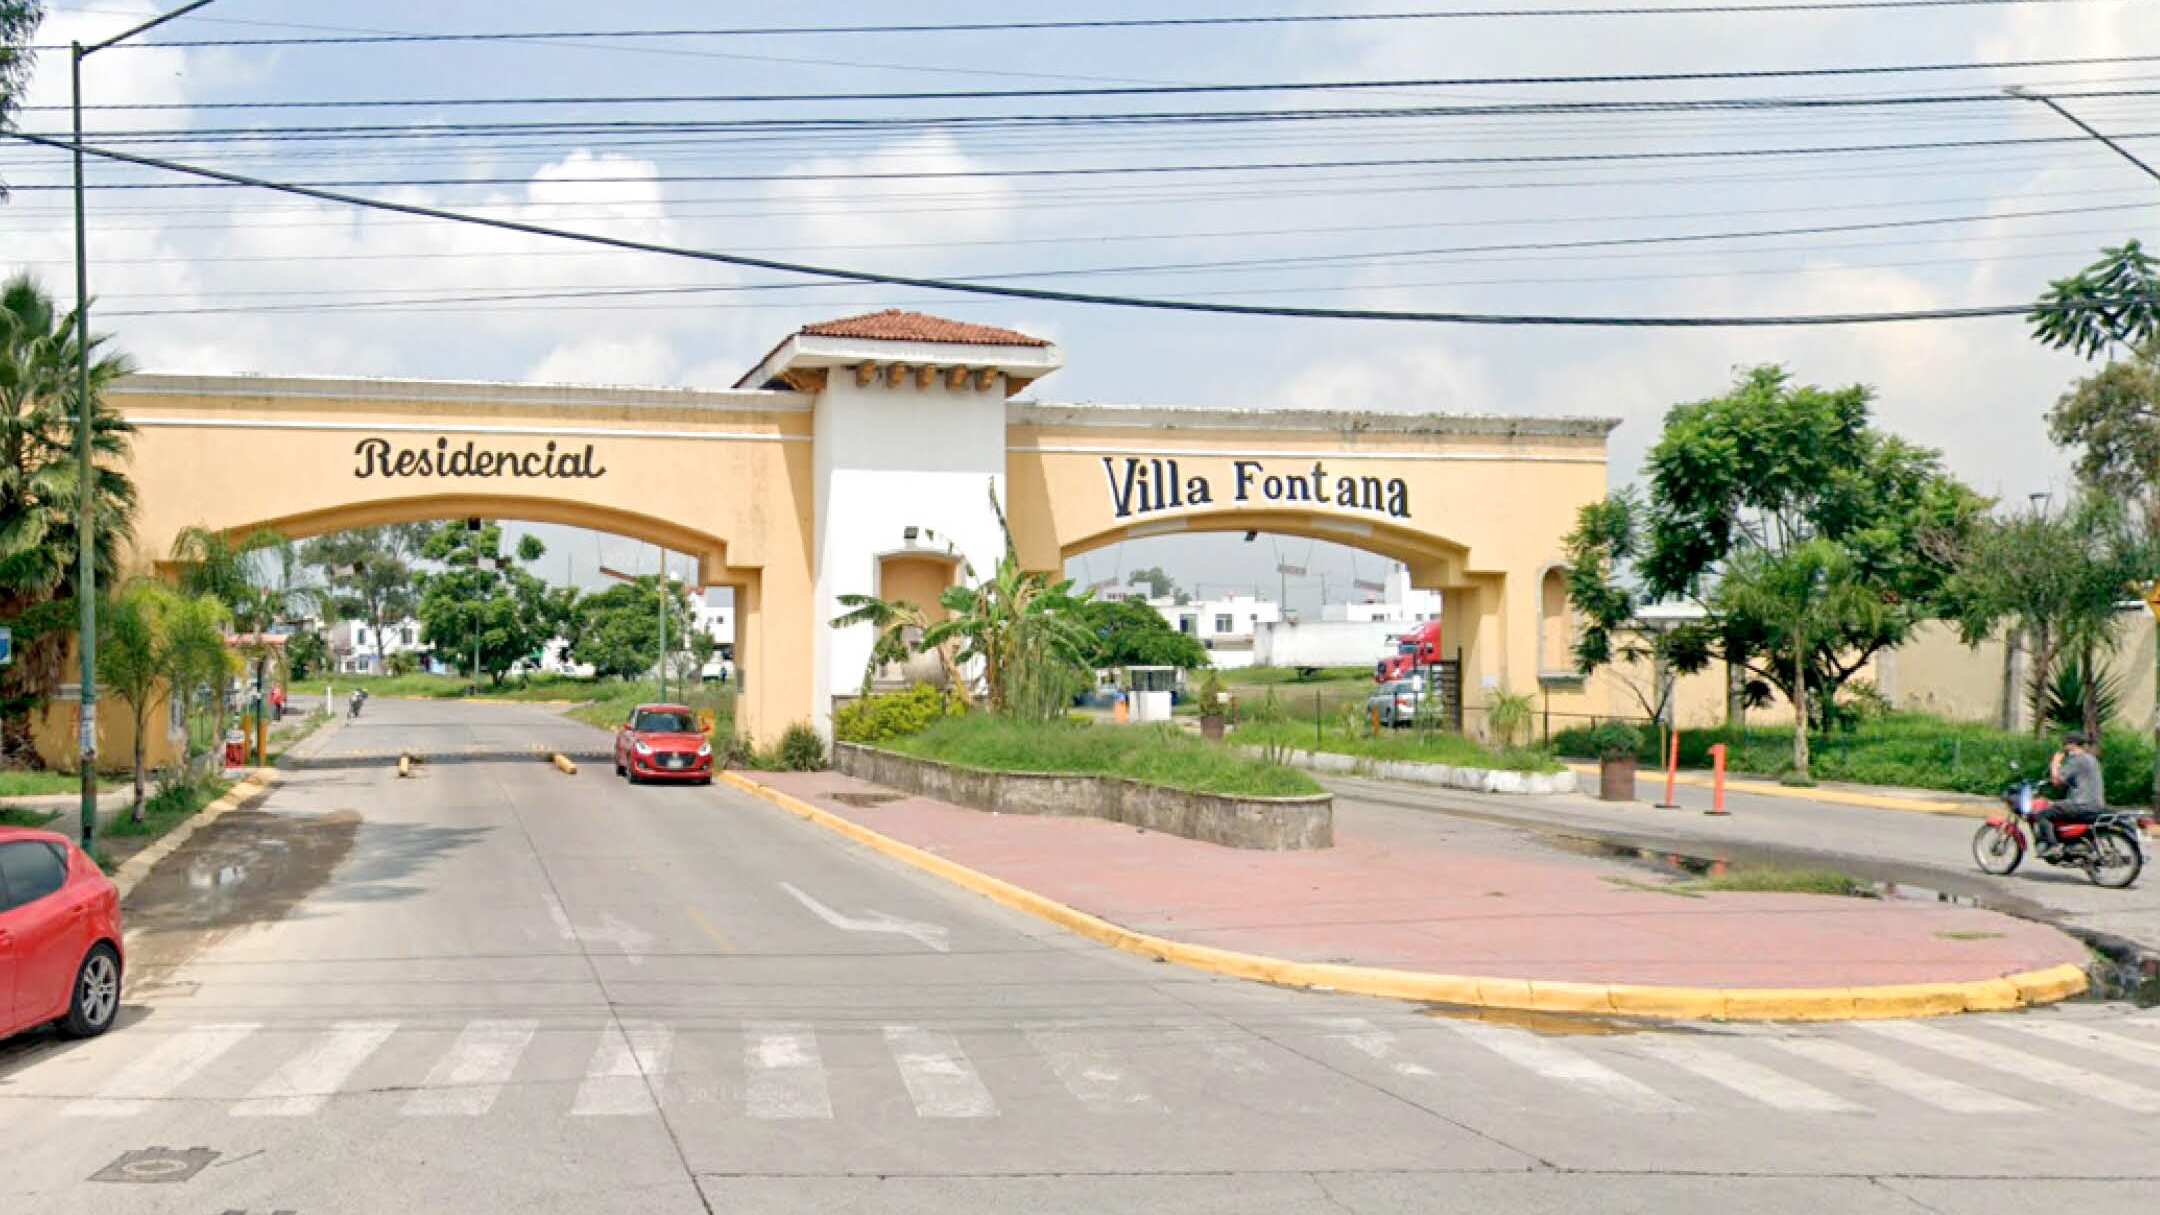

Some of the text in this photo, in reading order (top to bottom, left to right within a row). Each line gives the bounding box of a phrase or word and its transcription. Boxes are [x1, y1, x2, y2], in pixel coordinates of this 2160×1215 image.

[354, 437, 606, 479] Residencial
[1103, 456, 1412, 519] Villa Fontana
